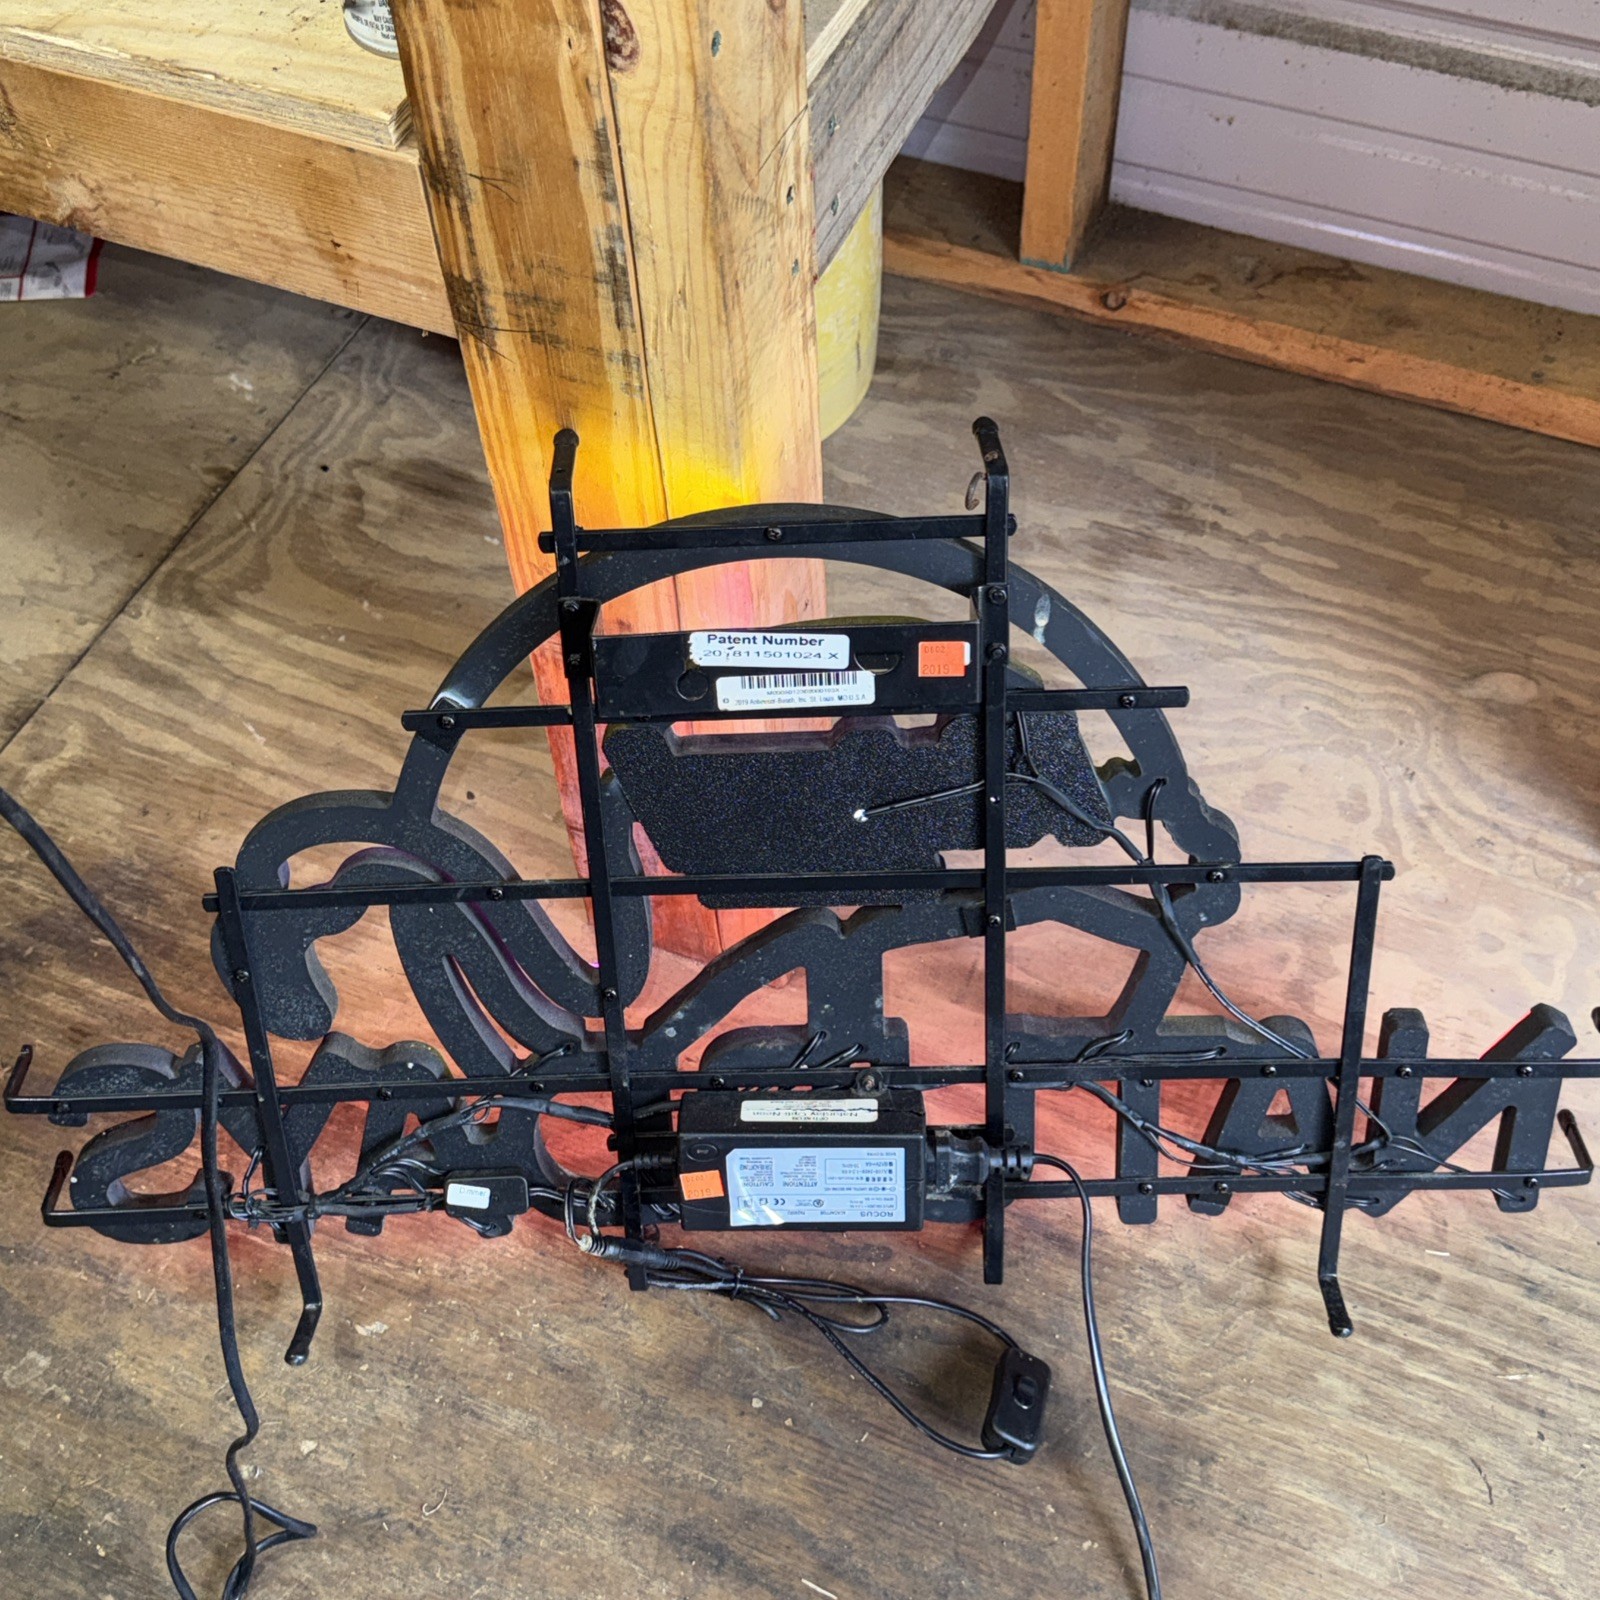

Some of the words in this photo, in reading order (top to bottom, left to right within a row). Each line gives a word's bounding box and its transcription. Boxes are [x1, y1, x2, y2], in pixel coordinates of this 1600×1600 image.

[707, 633, 758, 645] Patent
[762, 634, 825, 647] Number
[860, 1210, 894, 1218] ROCUS
